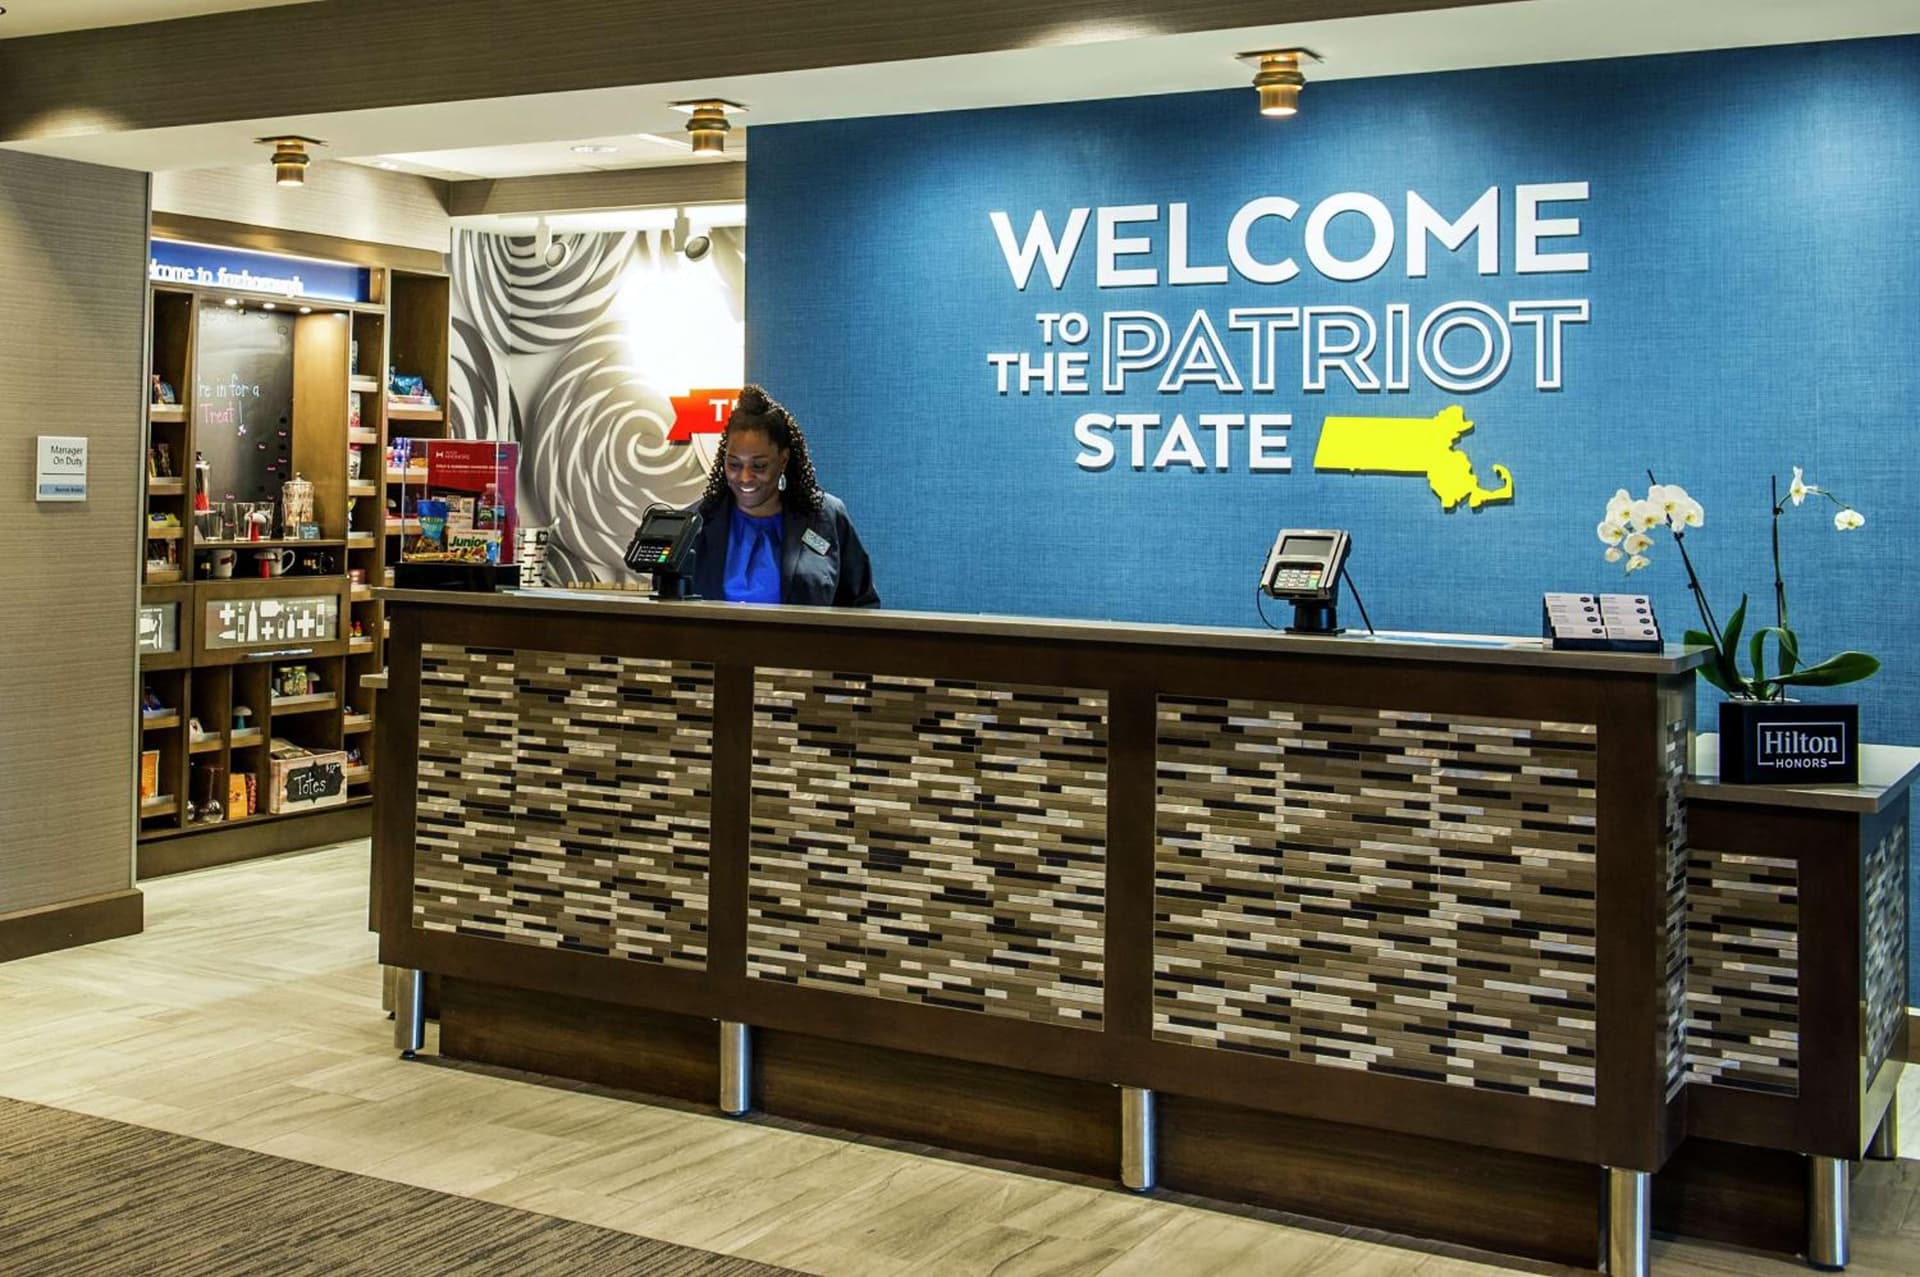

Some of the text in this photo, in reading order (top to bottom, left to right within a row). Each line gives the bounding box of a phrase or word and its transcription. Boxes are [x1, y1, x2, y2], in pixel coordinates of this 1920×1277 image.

[990, 181, 1590, 290] WELCOME
[197, 266, 213, 284] to
[1036, 312, 1088, 345] TO
[987, 299, 1590, 394] THE PATRIOT
[229, 373, 248, 397] for
[252, 385, 260, 397] a
[50, 445, 83, 457] Manager
[1074, 413, 1292, 469] STATE
[53, 456, 83, 467] On Duty
[1765, 731, 1838, 754] Hilton
[1776, 758, 1828, 769] HONORS
[294, 772, 326, 795] Totes
